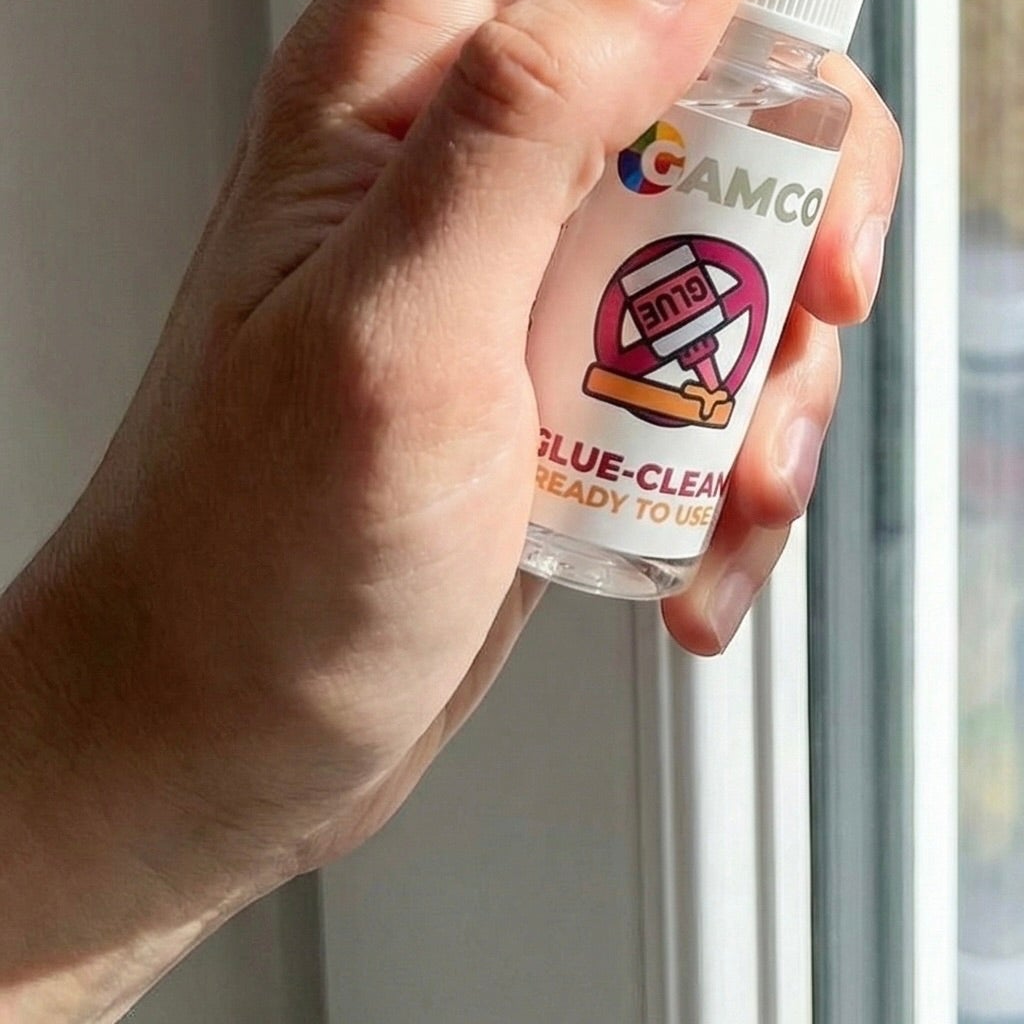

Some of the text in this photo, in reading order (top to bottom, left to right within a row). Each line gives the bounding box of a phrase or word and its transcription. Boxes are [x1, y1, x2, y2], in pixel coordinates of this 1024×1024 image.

[617, 120, 823, 227] GAMCO
[637, 275, 708, 331] GLUE
[636, 498, 670, 523] TO
[675, 505, 713, 526] USE
